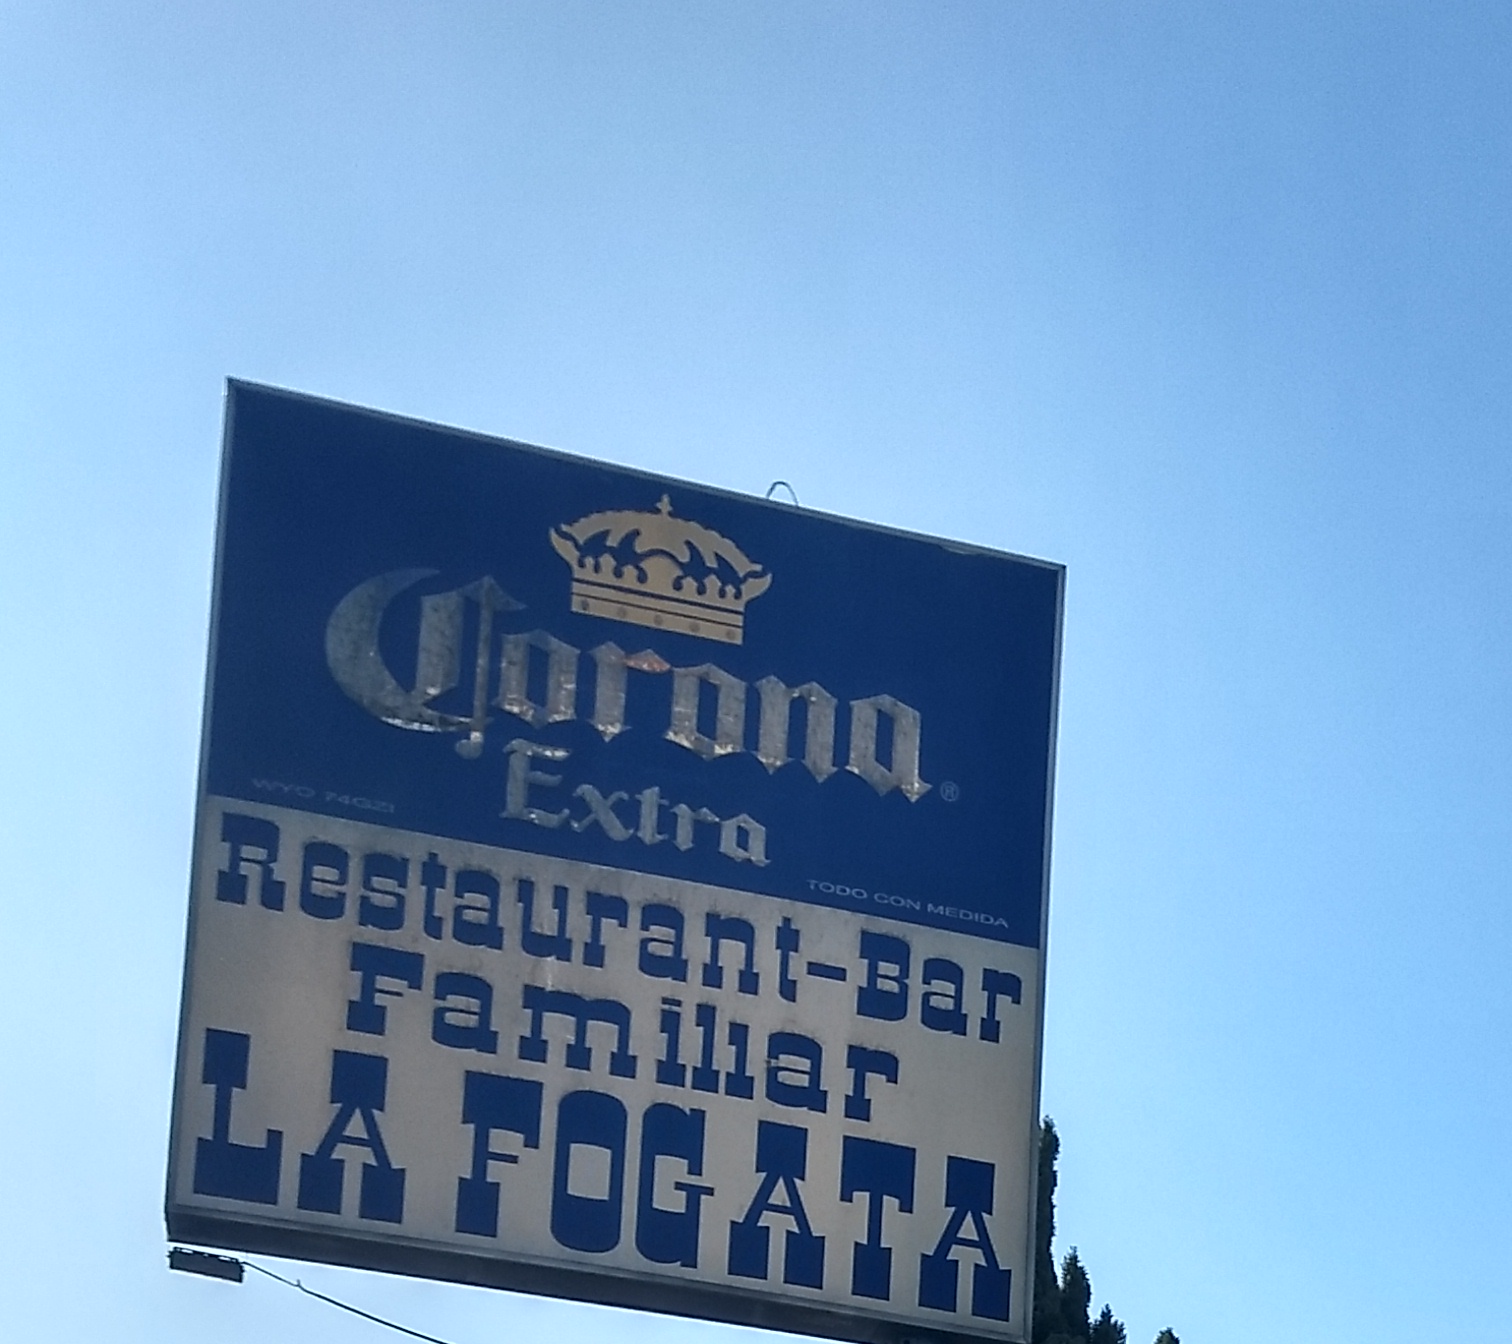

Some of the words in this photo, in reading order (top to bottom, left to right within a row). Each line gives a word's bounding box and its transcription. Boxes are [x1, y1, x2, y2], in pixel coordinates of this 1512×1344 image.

[325, 567, 932, 803] Corona
[500, 738, 771, 868] Extra
[806, 879, 868, 900] TODO
[873, 892, 921, 911] CON
[926, 903, 1009, 929] MEDIDA
[215, 811, 1022, 1044] Restaurant-Bar
[345, 941, 899, 1122] Familiar
[194, 1027, 406, 1224] LA
[455, 1069, 1013, 1322] FOGATA
